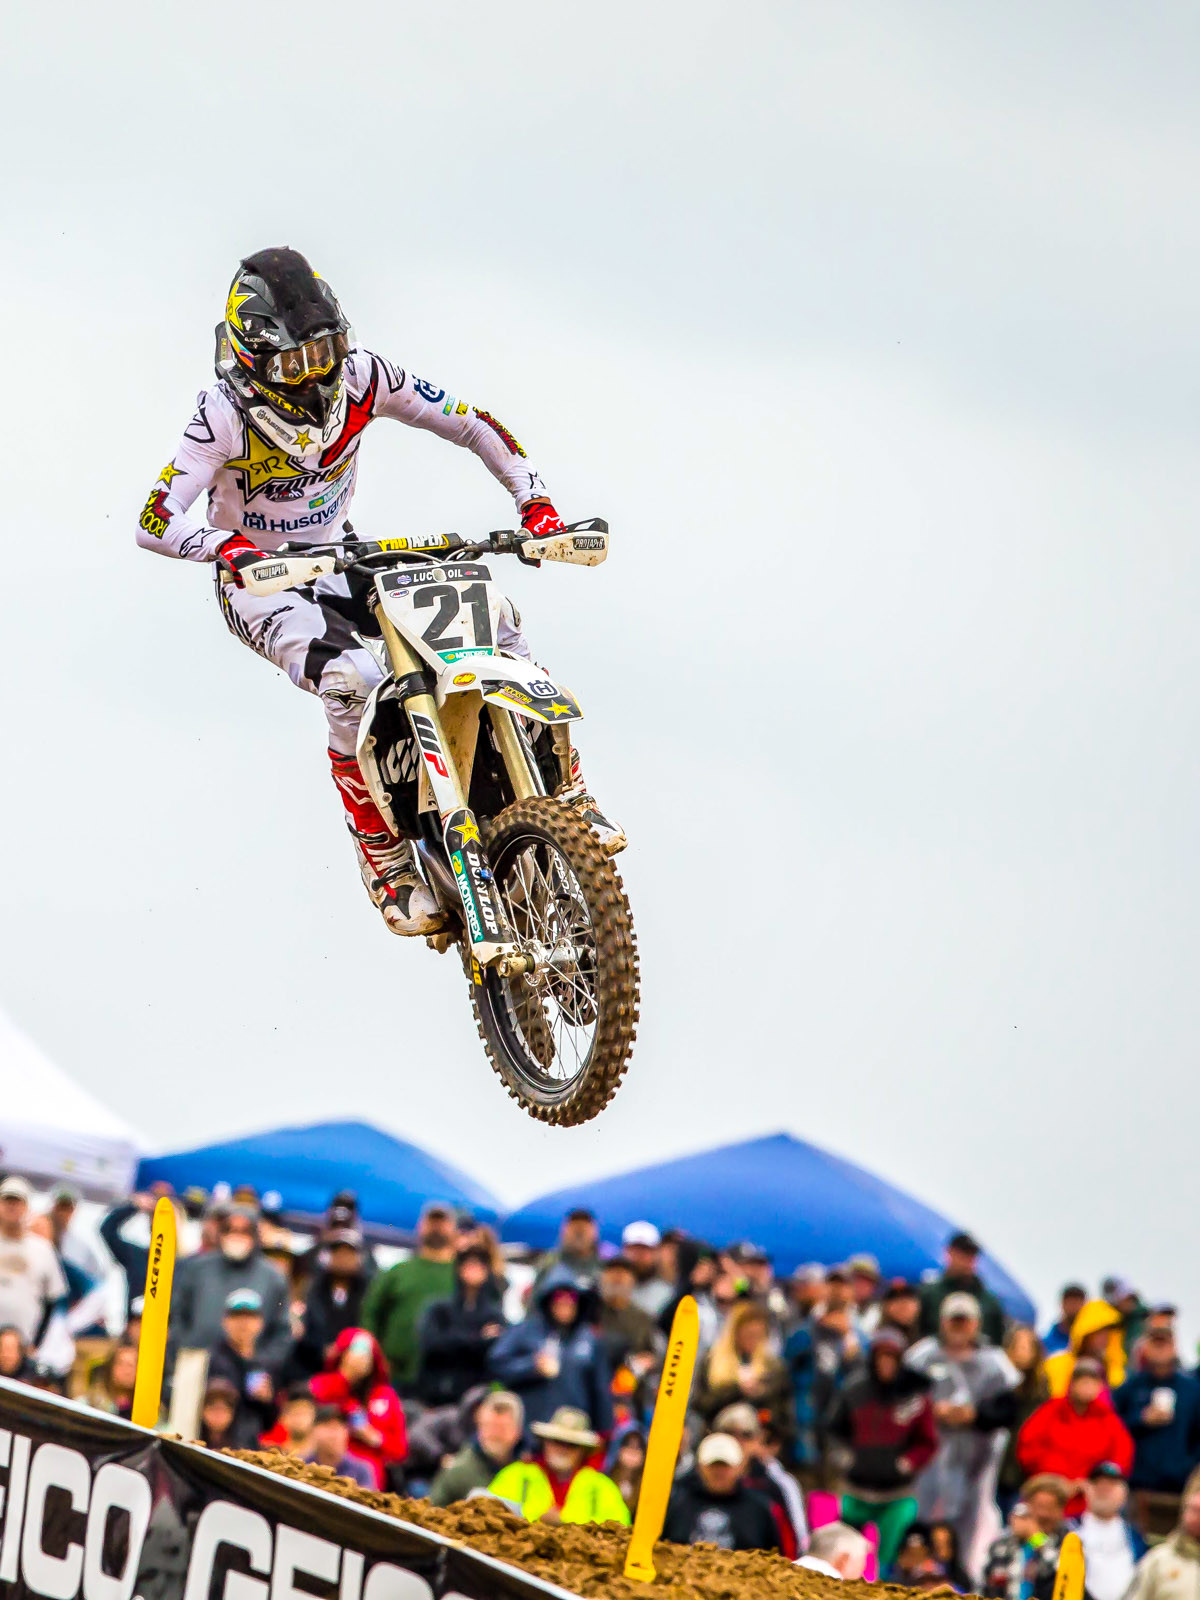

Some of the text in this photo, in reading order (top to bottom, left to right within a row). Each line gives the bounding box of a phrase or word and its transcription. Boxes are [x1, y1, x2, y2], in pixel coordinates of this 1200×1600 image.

[413, 571, 437, 583] LUC
[448, 568, 463, 578] OIL
[413, 583, 493, 652] 21
[457, 873, 482, 940] MOTOREX
[150, 1233, 164, 1299] ACERBIS
